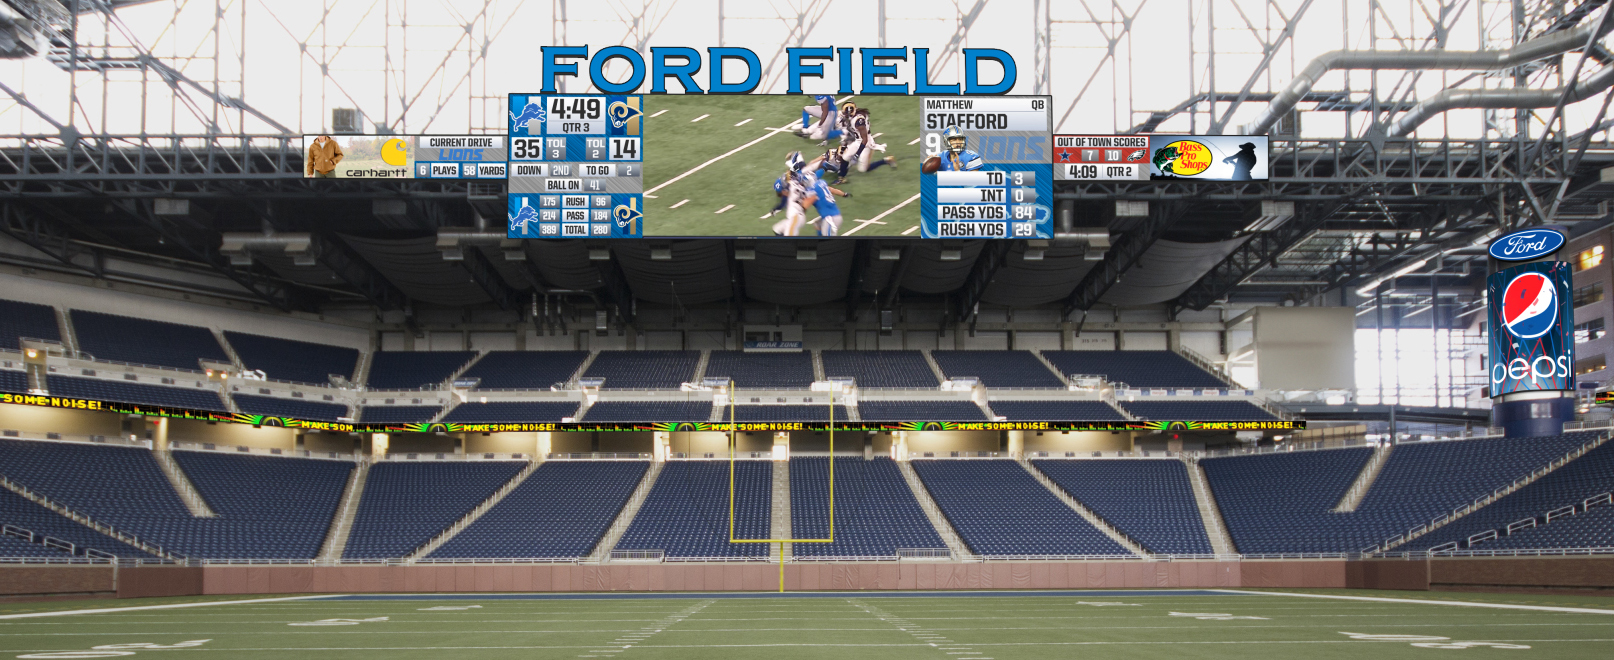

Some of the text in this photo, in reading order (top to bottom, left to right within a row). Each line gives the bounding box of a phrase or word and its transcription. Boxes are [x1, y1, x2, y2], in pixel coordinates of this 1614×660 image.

[540, 44, 1017, 95] FORD FIELD
[551, 98, 601, 120] 4:49
[926, 99, 1044, 111] MATTHEW QB
[926, 113, 1008, 129] STAFFORD
[562, 122, 590, 132] QTR 3
[430, 138, 492, 147] CURRENT DRIVE
[546, 139, 565, 148] TOL
[586, 139, 605, 148] TOL
[925, 132, 1046, 161] 9 IONS
[1057, 137, 1146, 147] OUT OF TOWN SCORES
[1179, 141, 1202, 151] Bass
[514, 139, 540, 159] 35
[552, 149, 560, 159] 3
[592, 149, 599, 159] 2
[613, 139, 636, 159] 14
[1087, 151, 1093, 160] 7
[1107, 151, 1119, 160] 10
[1180, 151, 1197, 160] Pro
[517, 165, 632, 175] DOWN 2ND TO GO 2
[1180, 159, 1208, 171] Shops
[346, 168, 408, 177] carhartt
[419, 166, 505, 176] 6 PLAYS 58 YARDS
[1069, 165, 1098, 179] 4:09
[1106, 166, 1132, 177] QTR 2
[986, 172, 1023, 185] TD 3
[547, 180, 600, 190] BALL ON 41
[980, 189, 1023, 202] INT 0
[543, 197, 606, 206] 175 RUSH 96
[542, 211, 608, 220] 214 PASS 184
[942, 206, 1032, 219] PASS YDS 84
[542, 225, 608, 235] 389 TOTAL 280
[940, 223, 1032, 236] RUSH YDS 29
[1503, 234, 1547, 255] Ford
[1492, 349, 1572, 396] pepsi
[3, 394, 102, 410] SOME NOISE!
[301, 421, 329, 430] MAKE
[463, 424, 490, 432] MAKE
[522, 423, 555, 431] NOISE!
[740, 423, 766, 431] SOME
[986, 422, 1012, 430] SOME
[1016, 422, 1049, 430] NOISE!
[1202, 422, 1228, 430] MAKE
[1260, 421, 1293, 429] NOISE!
